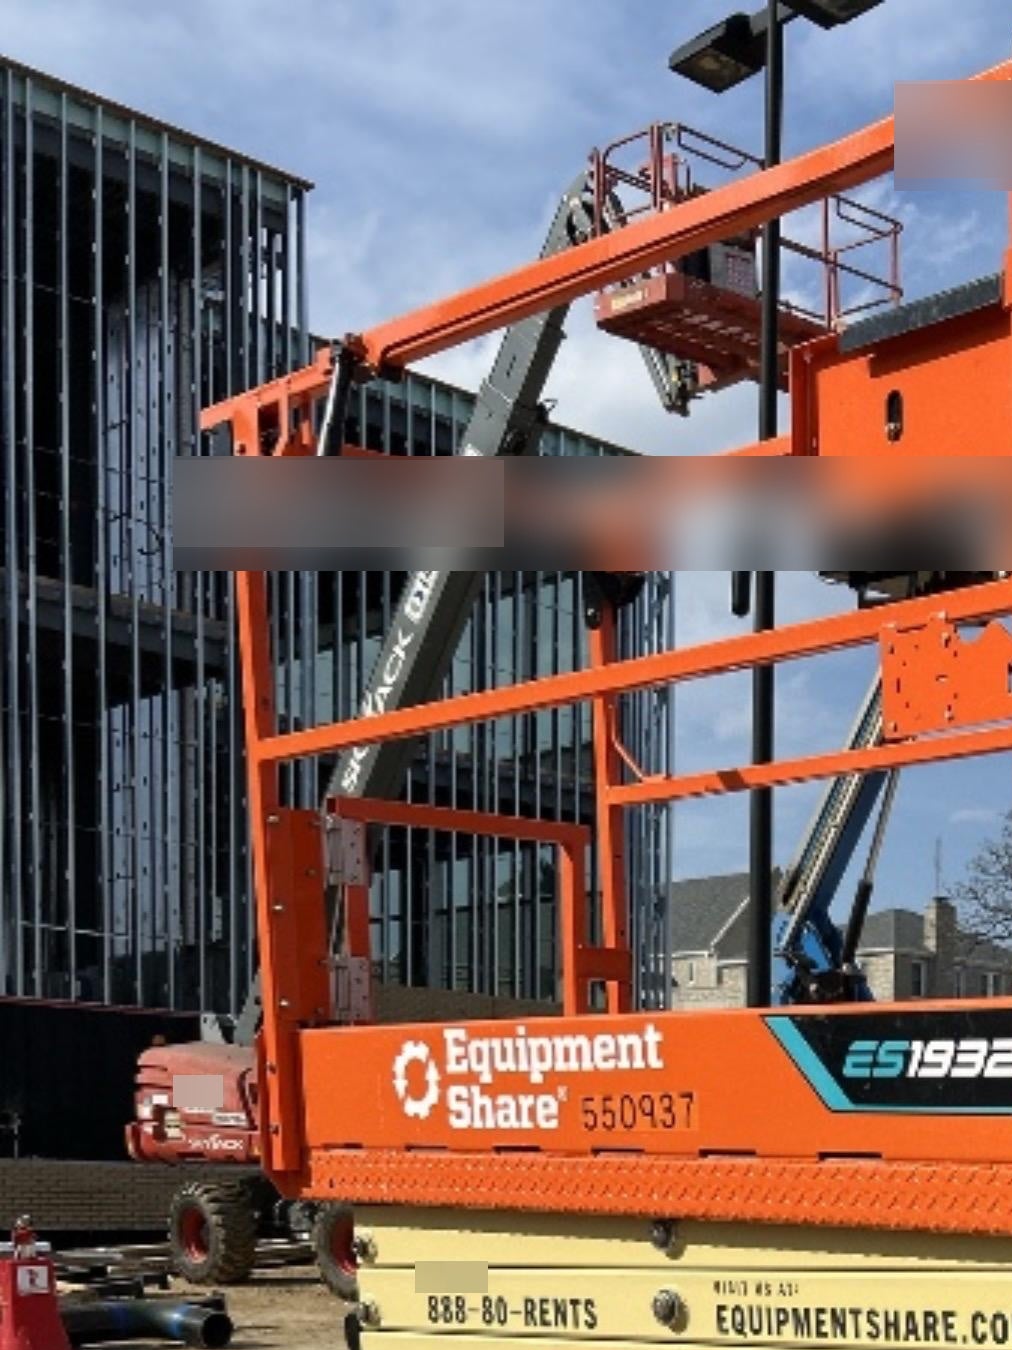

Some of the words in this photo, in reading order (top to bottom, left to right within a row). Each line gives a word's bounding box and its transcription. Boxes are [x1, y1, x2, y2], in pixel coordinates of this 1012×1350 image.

[442, 1022, 665, 1084] Equipment
[582, 1092, 695, 1132] 550937
[427, 1294, 598, 1330] 888-80-RENTS
